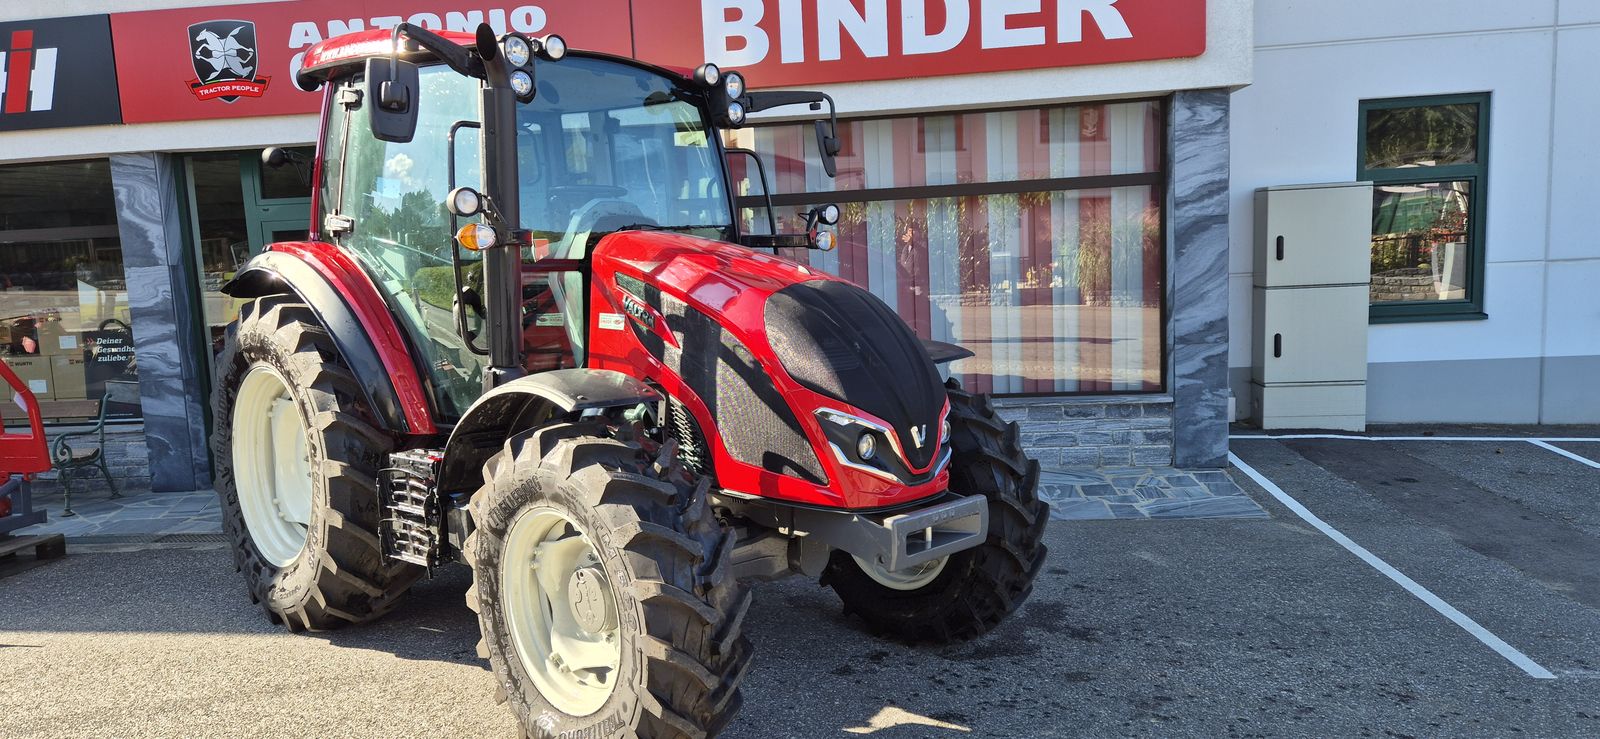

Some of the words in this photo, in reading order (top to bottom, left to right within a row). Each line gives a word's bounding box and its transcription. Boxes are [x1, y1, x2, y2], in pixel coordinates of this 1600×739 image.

[702, 0, 1134, 68] BINDER
[199, 85, 231, 96] TRACTOR
[231, 85, 260, 93] PEOPLE
[96, 337, 124, 345] Deiner
[97, 354, 128, 362] zuliebe.
